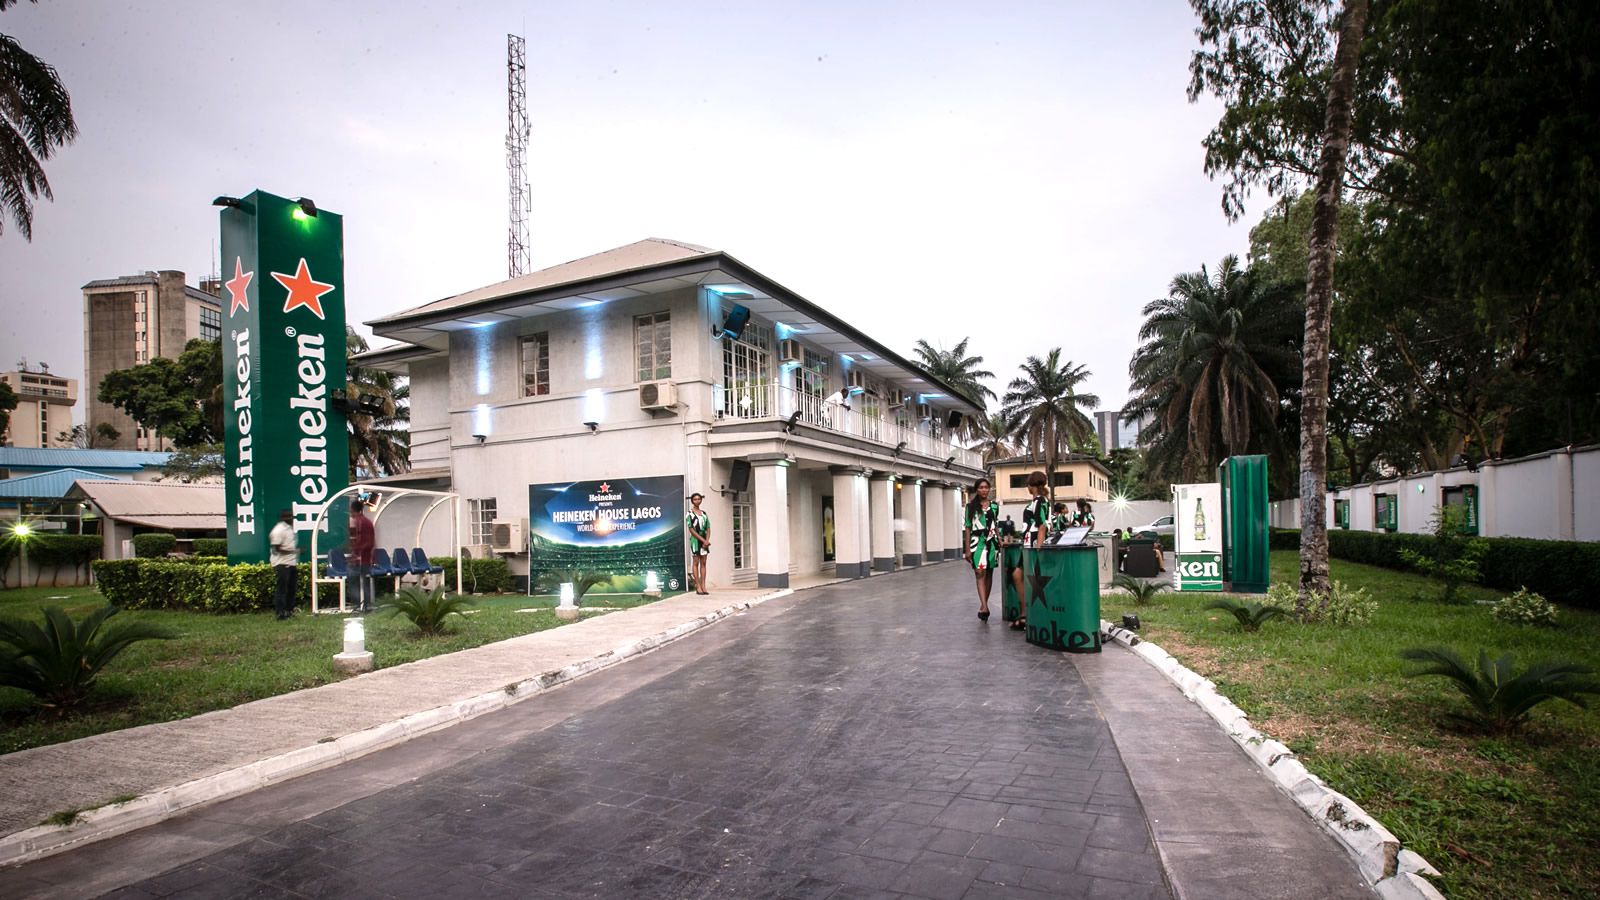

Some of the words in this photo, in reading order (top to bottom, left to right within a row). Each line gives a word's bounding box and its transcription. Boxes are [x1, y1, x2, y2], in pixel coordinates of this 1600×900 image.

[235, 328, 255, 535] Heineken
[290, 334, 328, 533] Heineken
[589, 494, 621, 503] Heineken
[553, 510, 596, 523] HEINEKEN
[598, 508, 629, 521] HOUSE
[631, 507, 661, 519] LAGOS
[577, 523, 607, 532] WORLD-C
[1180, 561, 1220, 577] ken
